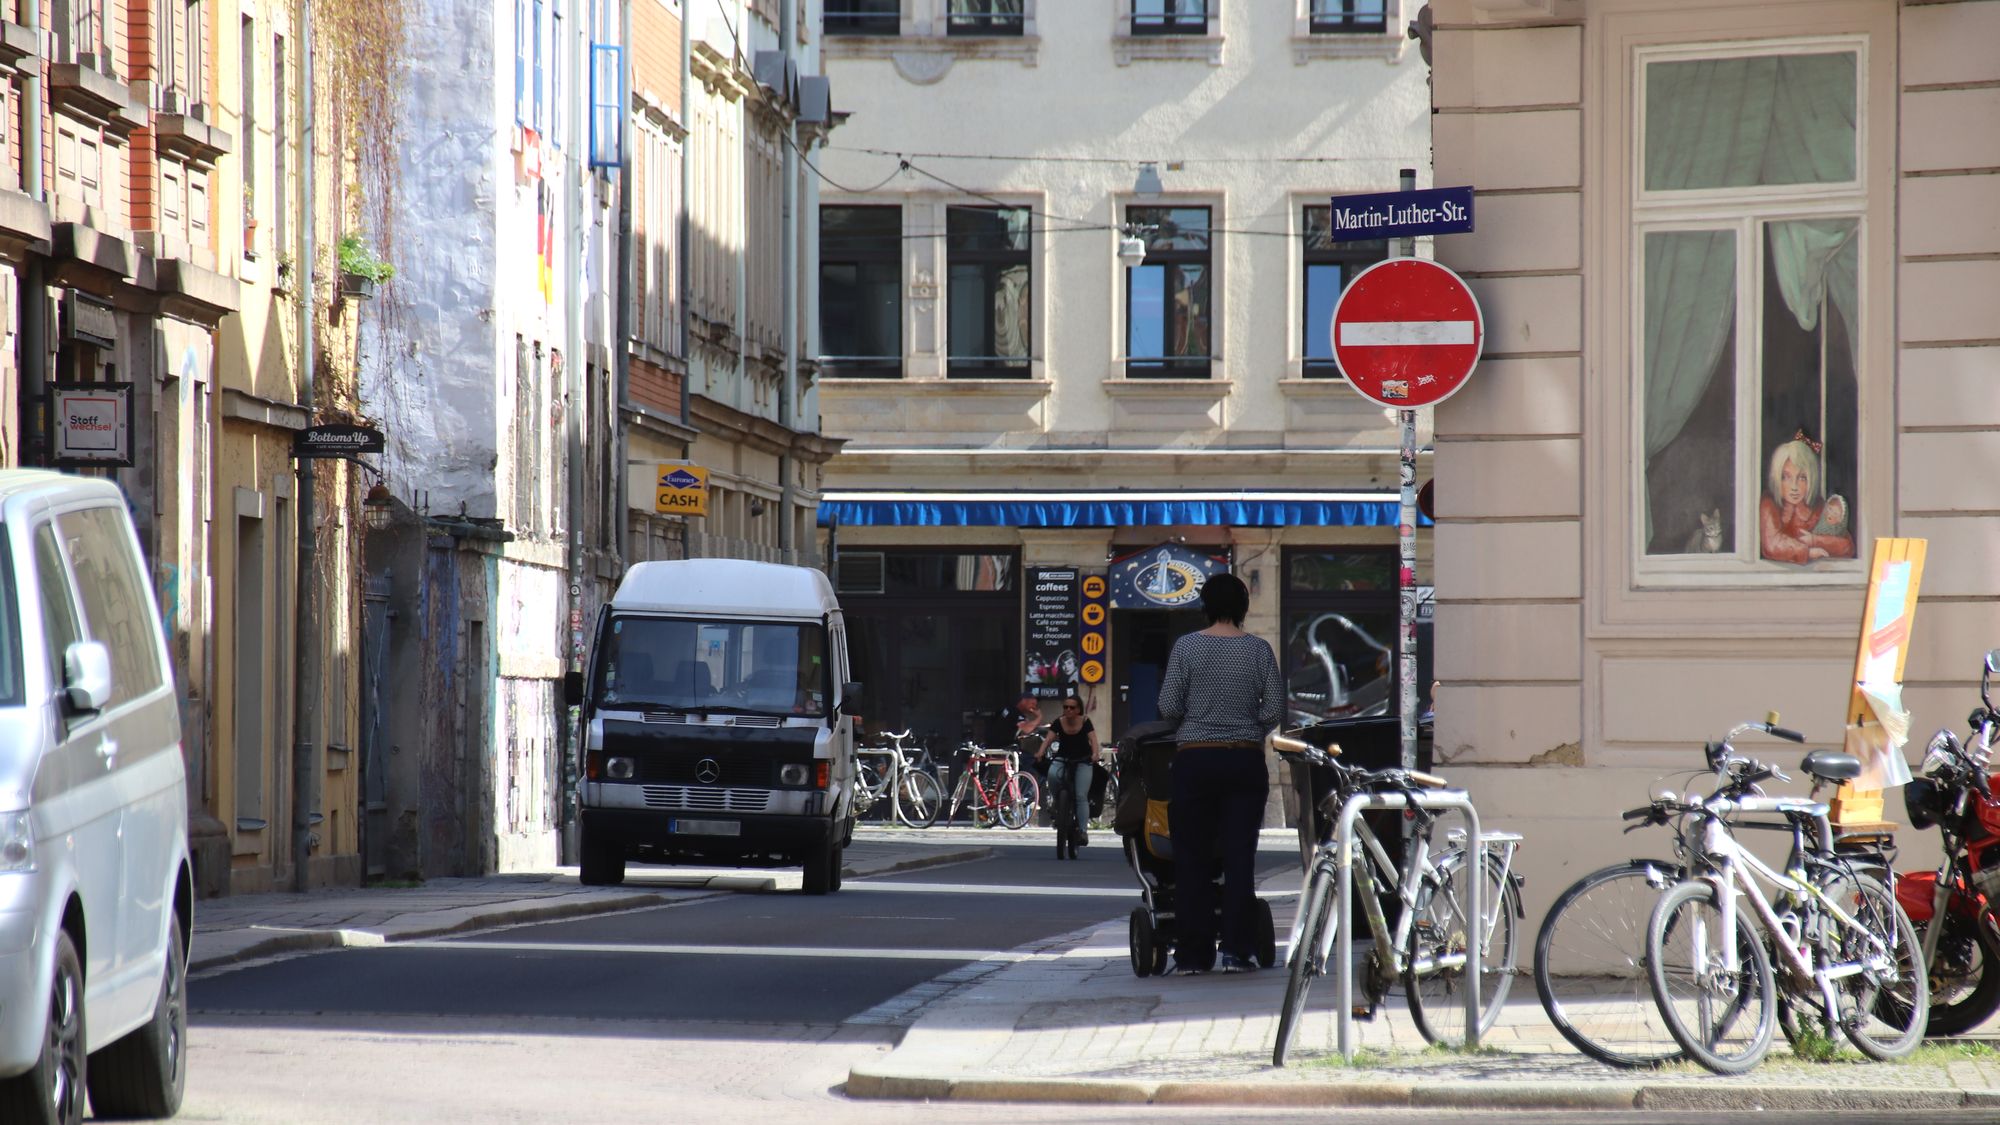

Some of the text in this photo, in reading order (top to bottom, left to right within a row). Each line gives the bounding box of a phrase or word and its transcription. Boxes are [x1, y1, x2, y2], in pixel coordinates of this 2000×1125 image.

[1335, 200, 1468, 230] Martin-Luther-Str.
[70, 415, 99, 425] Stoff
[70, 423, 112, 431] wechsel
[308, 431, 370, 446] Bottoms Up
[659, 493, 699, 507] CASH
[1035, 582, 1069, 592] coffees
[1035, 595, 1069, 603] Cappuccino
